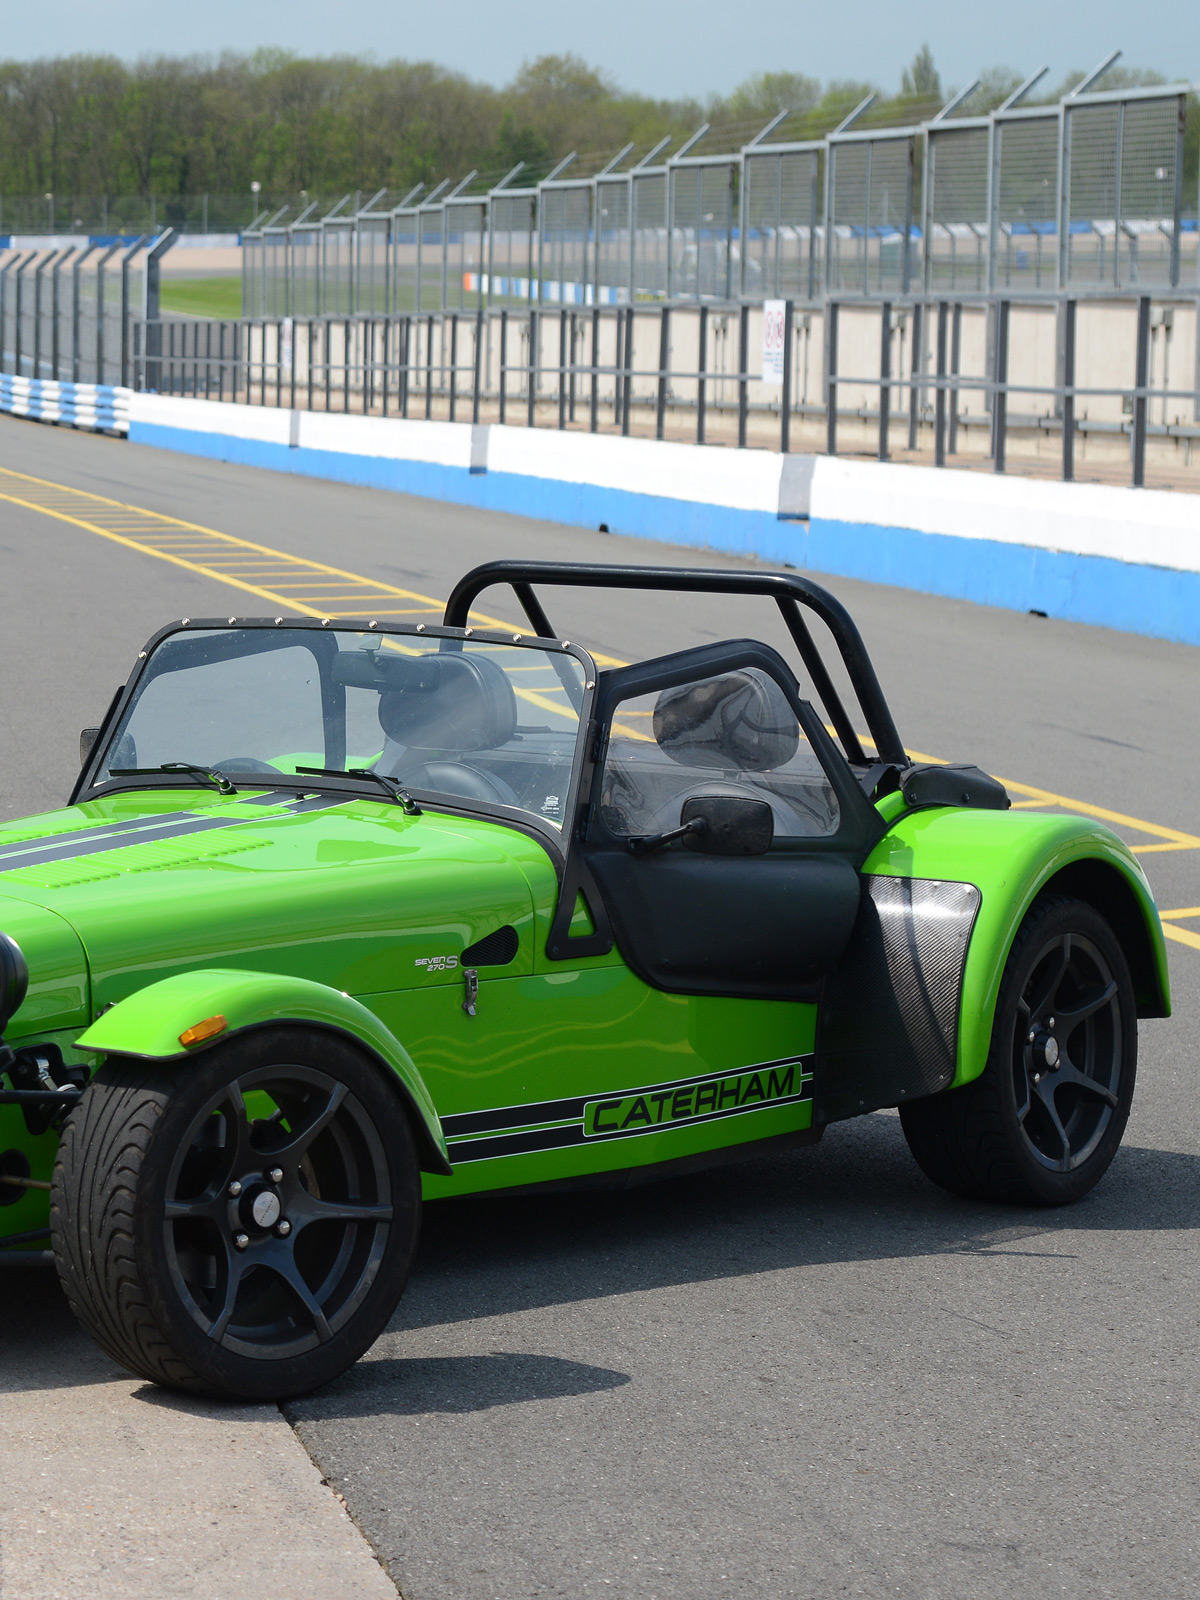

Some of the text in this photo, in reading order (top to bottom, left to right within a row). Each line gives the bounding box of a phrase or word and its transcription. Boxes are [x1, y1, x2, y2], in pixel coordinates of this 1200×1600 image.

[427, 963, 445, 972] 270
[445, 955, 458, 969] S
[593, 1066, 795, 1132] CATERHAM
